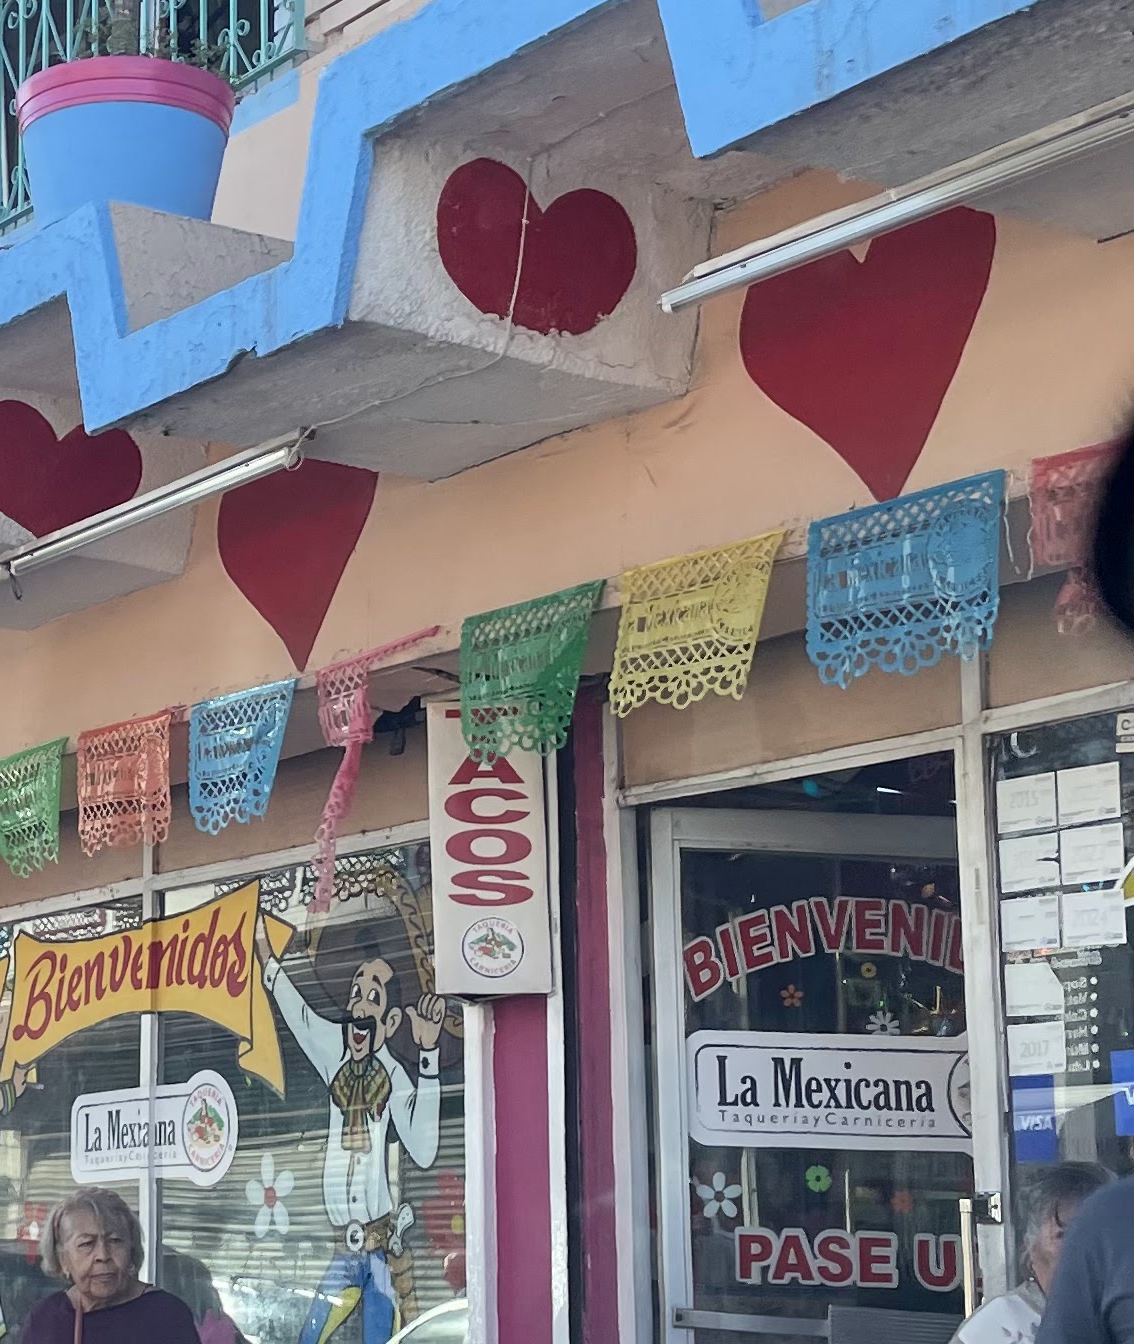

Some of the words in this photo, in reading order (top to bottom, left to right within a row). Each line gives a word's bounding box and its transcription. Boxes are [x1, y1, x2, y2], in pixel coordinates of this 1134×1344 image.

[444, 709, 534, 906] ACOS
[13, 907, 249, 1041] Bienvenidos
[683, 896, 964, 1002] BIENVENI
[716, 1055, 759, 1107] La
[771, 1057, 935, 1113] Mexicana
[84, 1113, 103, 1153] La
[1019, 1115, 1054, 1131] VISA
[734, 1226, 899, 1289] PASE
